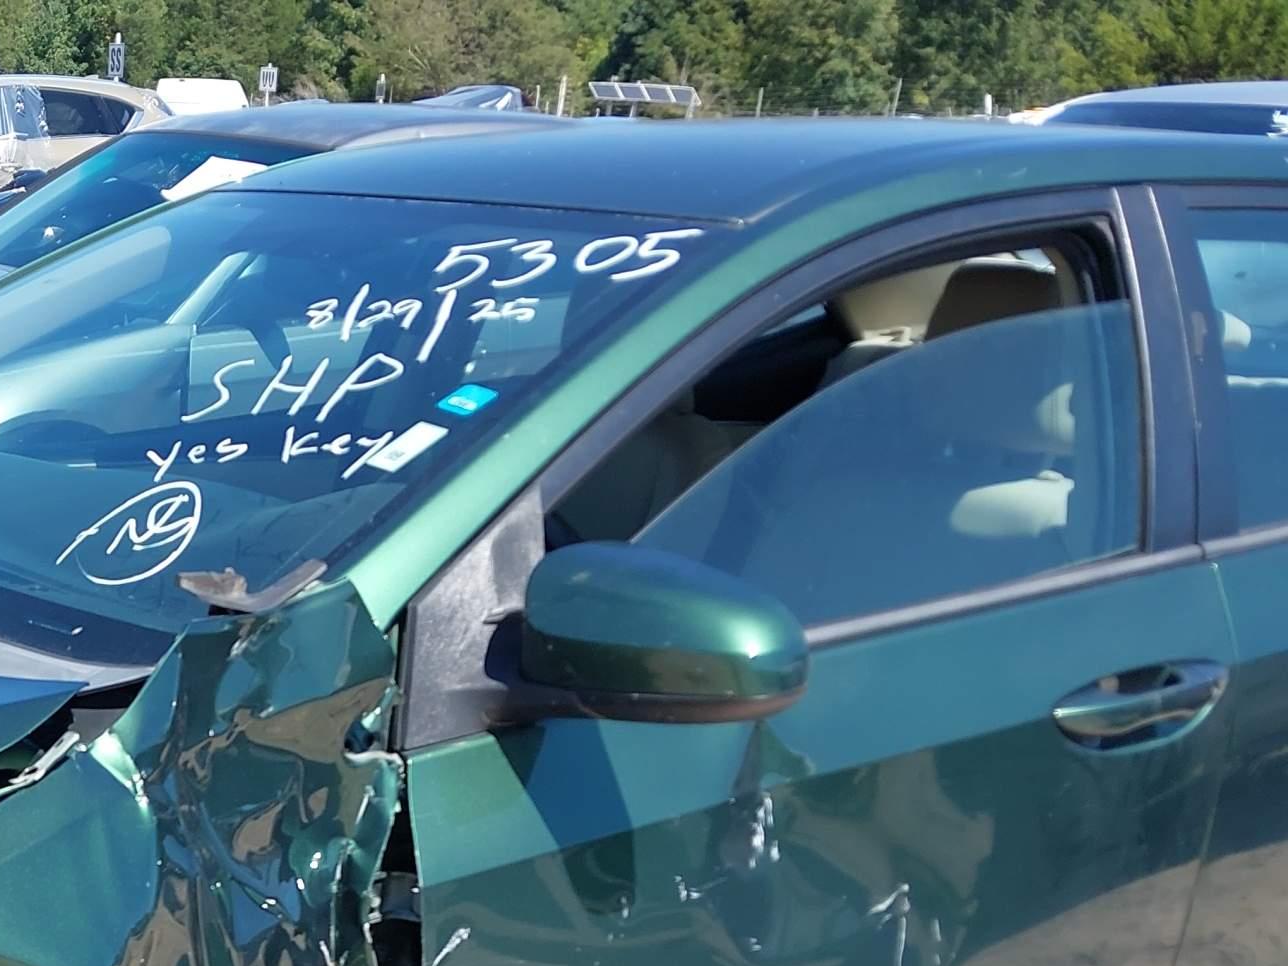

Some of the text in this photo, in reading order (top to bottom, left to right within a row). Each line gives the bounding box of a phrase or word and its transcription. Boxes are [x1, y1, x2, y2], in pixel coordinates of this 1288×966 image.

[110, 47, 122, 72] SS
[433, 228, 705, 294] 5305
[180, 352, 405, 423] SHP
